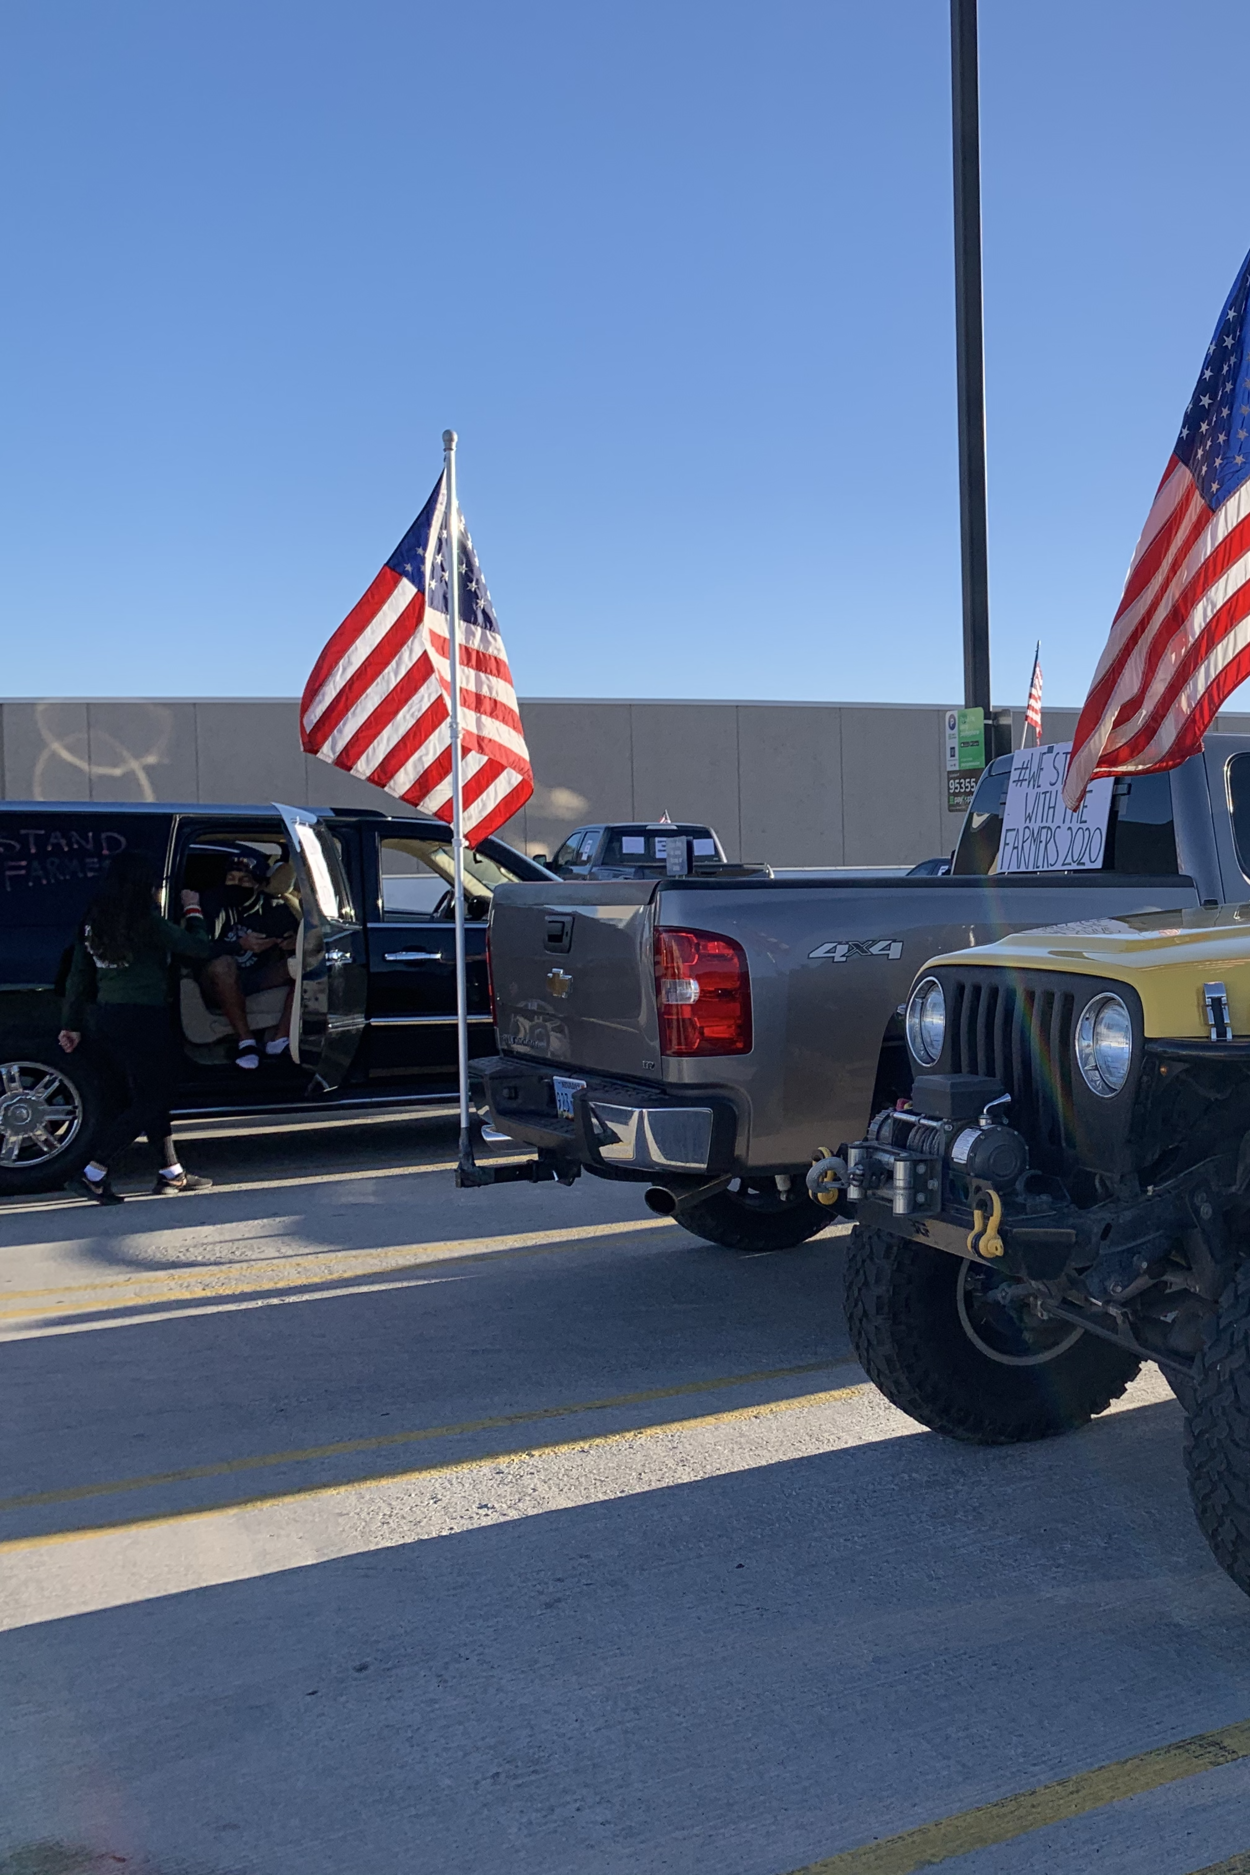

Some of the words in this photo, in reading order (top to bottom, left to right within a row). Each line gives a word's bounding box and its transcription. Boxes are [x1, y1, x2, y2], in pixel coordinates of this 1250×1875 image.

[948, 778, 976, 793] 95355
[1024, 789, 1058, 824] WITH
[999, 825, 1061, 870] FARMERS
[1061, 826, 1103, 866] 2020
